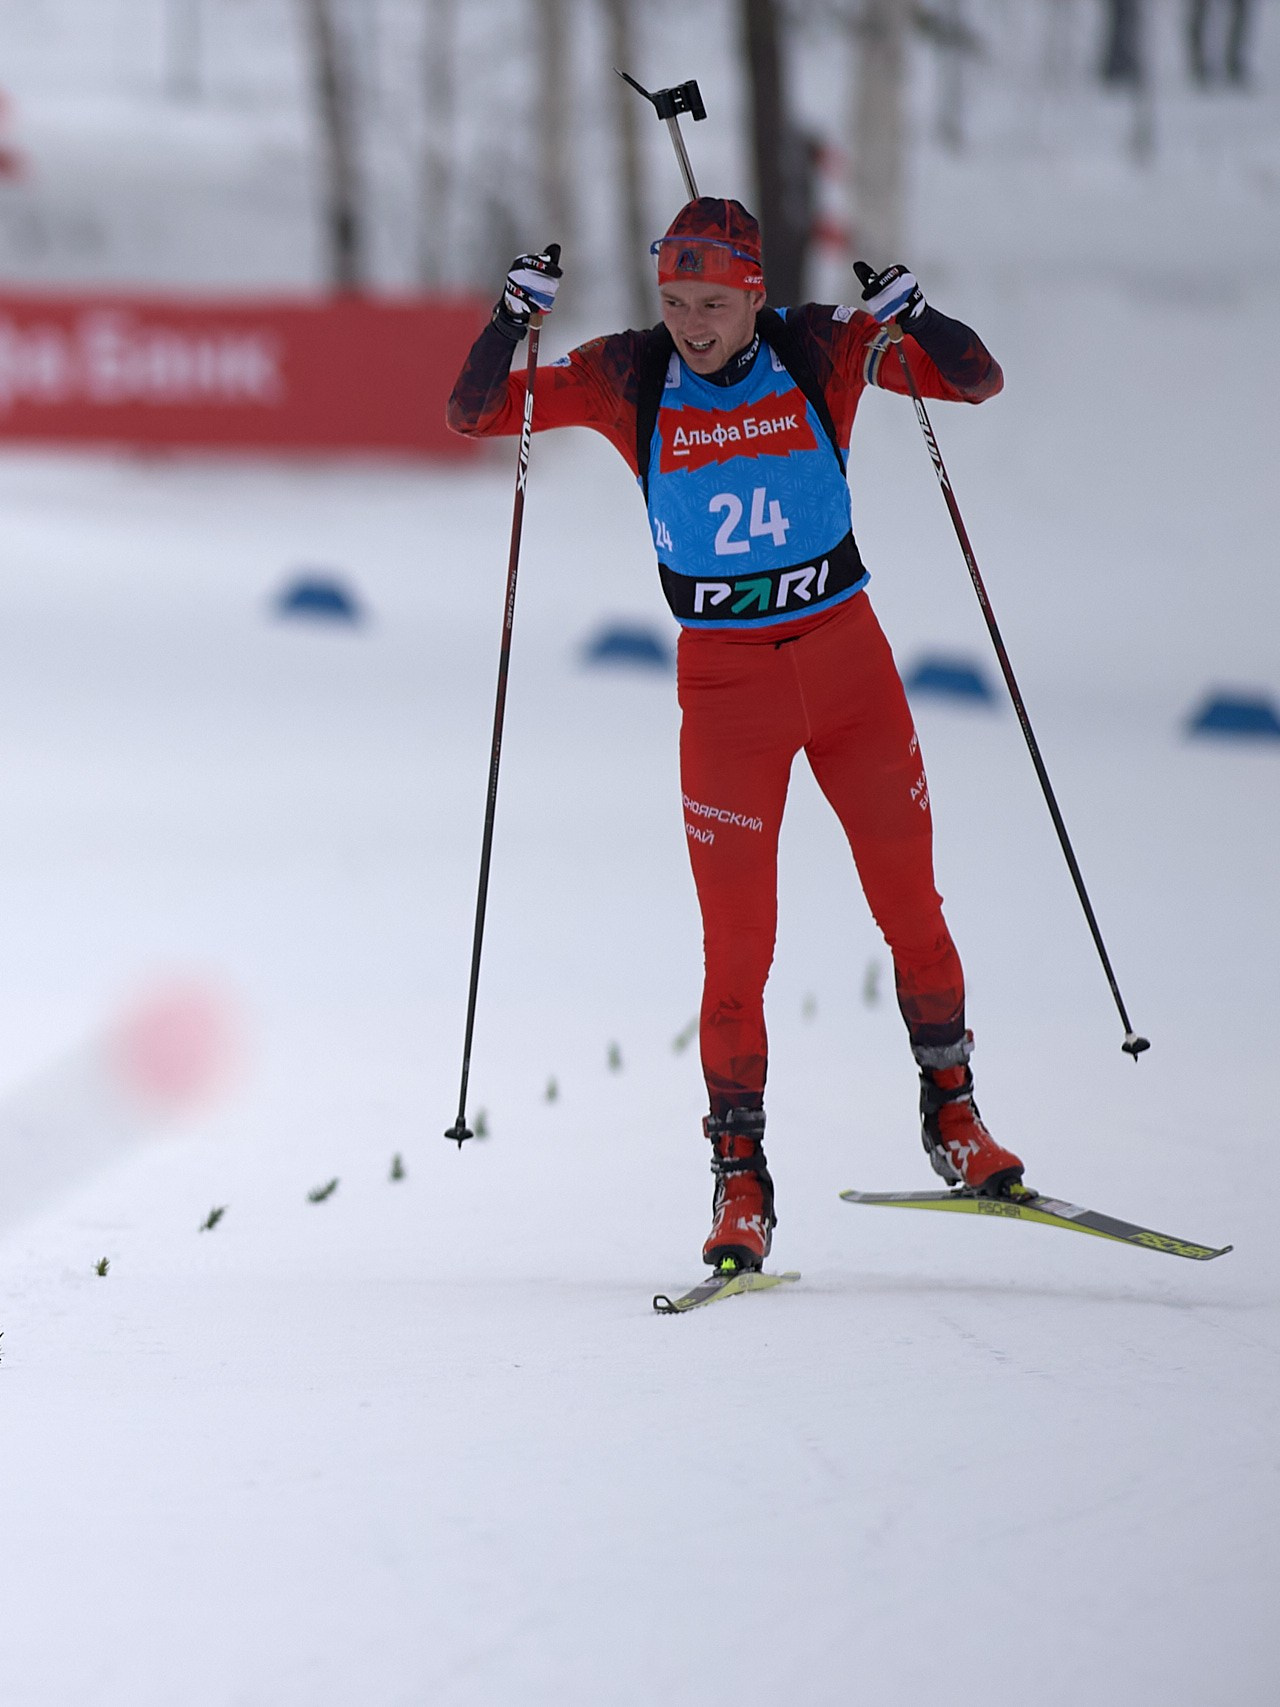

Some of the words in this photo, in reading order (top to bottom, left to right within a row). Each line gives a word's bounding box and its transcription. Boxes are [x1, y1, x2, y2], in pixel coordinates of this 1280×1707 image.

[672, 426, 741, 456] Альфа
[744, 414, 799, 440] Банк
[654, 517, 673, 552] 24
[708, 487, 790, 556] 24
[977, 1201, 1021, 1217] FISCHER
